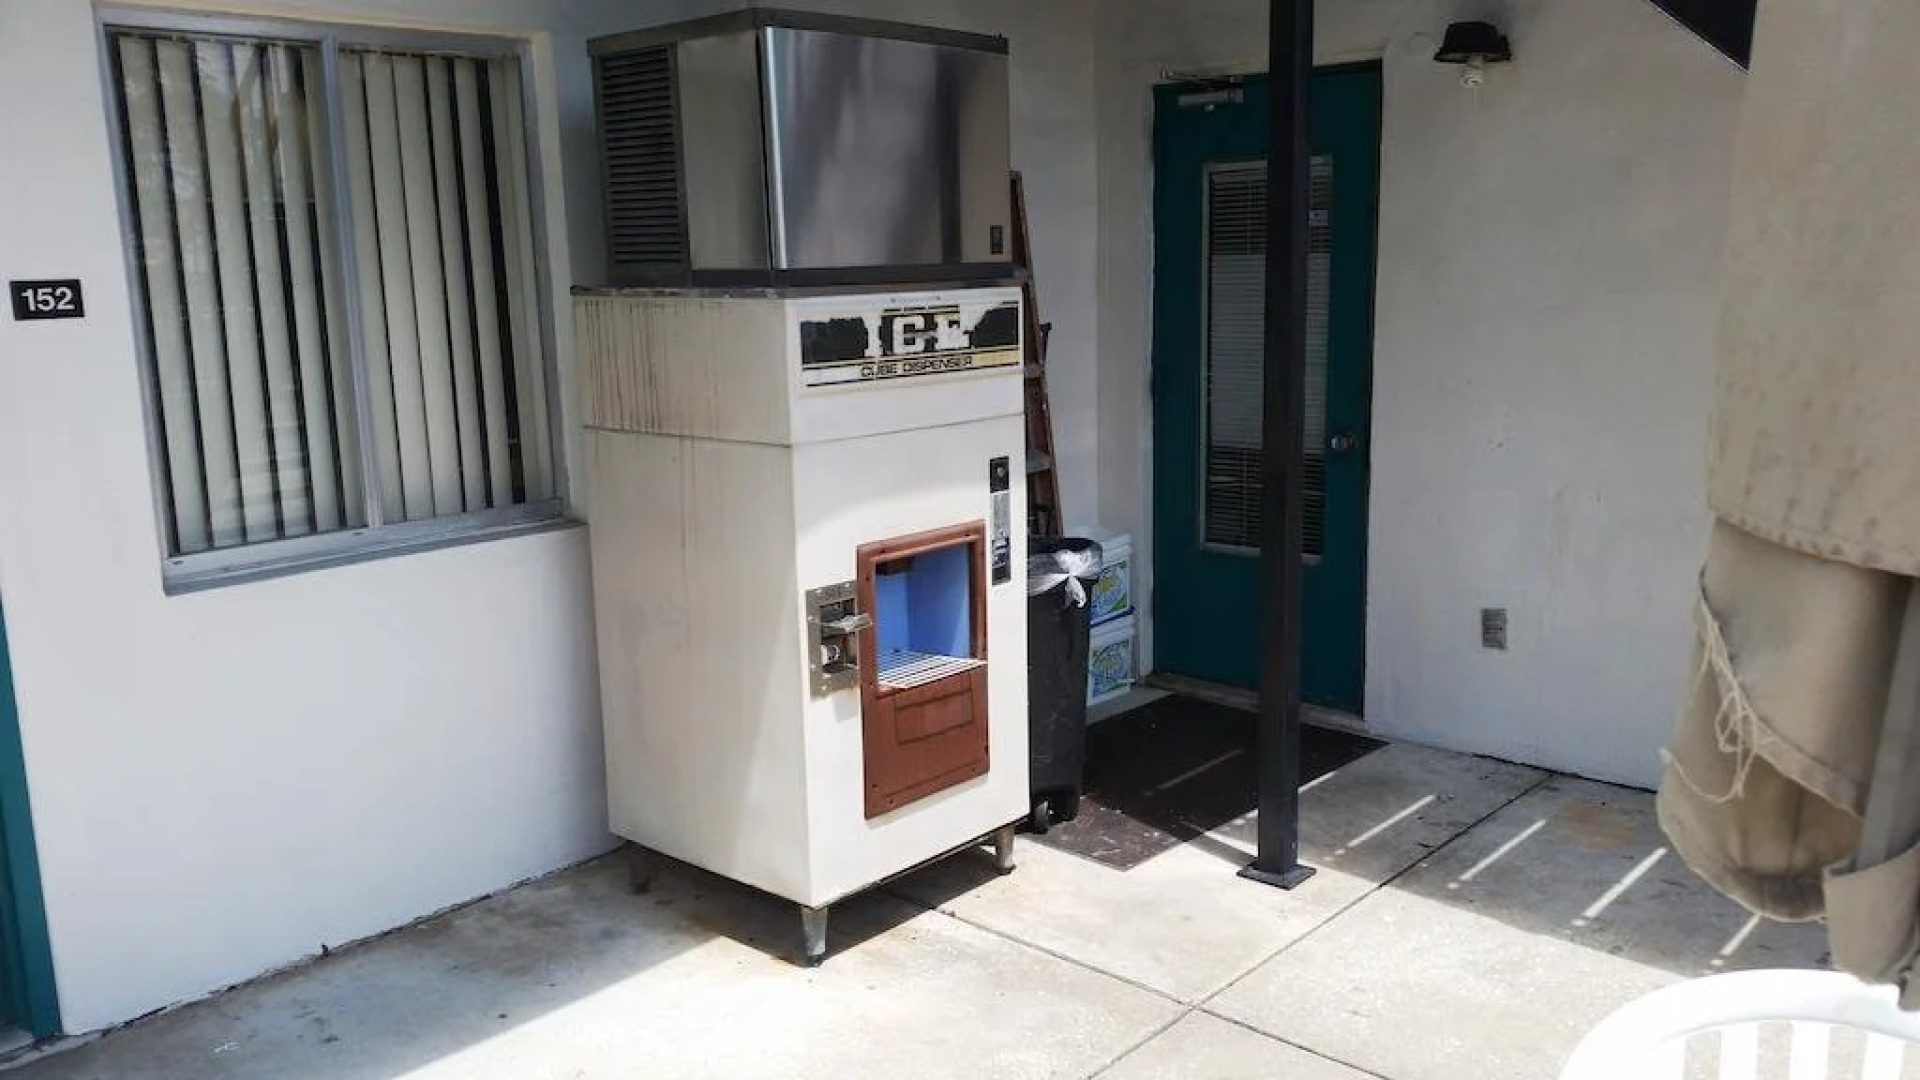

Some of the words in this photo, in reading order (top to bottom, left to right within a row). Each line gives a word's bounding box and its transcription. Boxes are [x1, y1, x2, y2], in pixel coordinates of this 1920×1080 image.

[22, 287, 75, 311] 152
[860, 362, 898, 377] CUBE
[902, 355, 972, 373] DISPENSER
